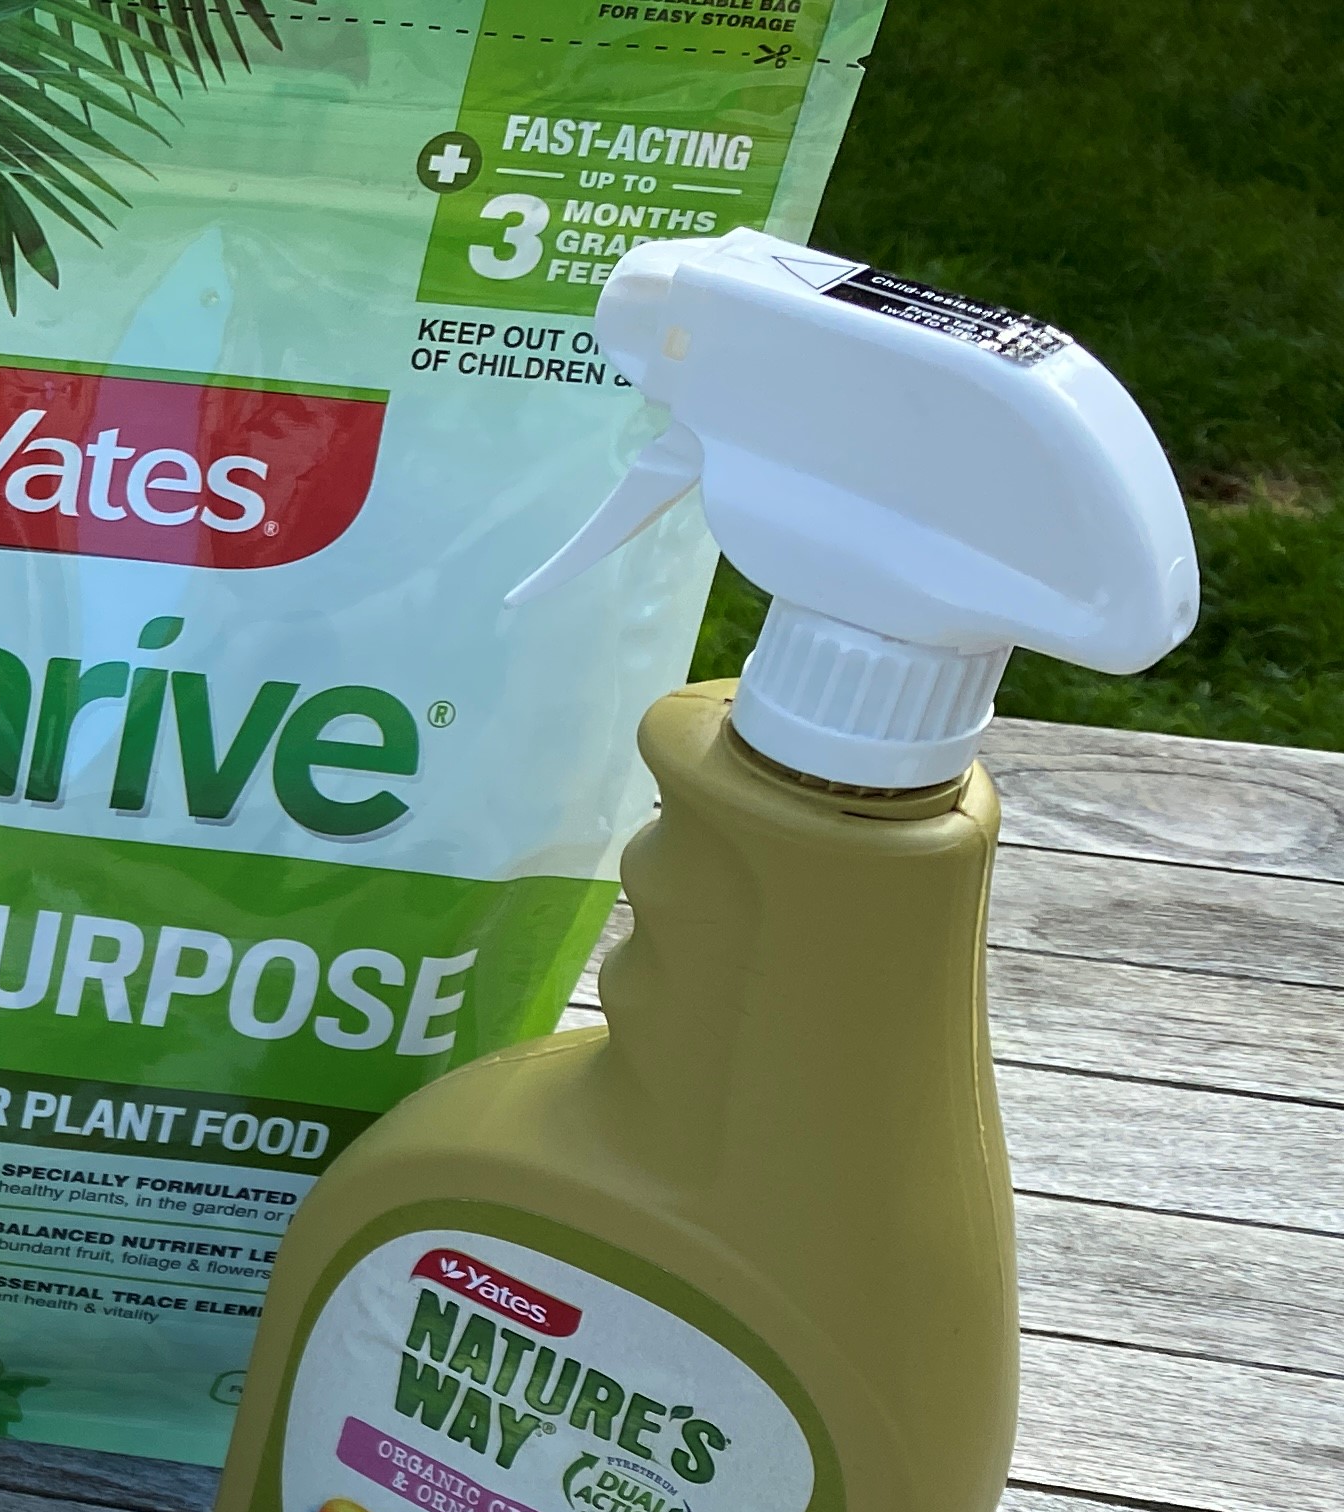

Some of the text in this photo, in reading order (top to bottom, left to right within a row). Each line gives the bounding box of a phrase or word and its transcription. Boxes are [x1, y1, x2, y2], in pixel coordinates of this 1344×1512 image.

[598, 4, 638, 20] FOR
[644, 7, 696, 24] EASY
[701, 12, 796, 32] STORAGE
[503, 114, 754, 172] FAST-ACTING
[579, 169, 657, 193] UP TO
[562, 200, 718, 231] MONTHS
[468, 192, 551, 280] 3
[417, 318, 564, 355] KEEP OUT
[411, 347, 606, 386] OF CHILDREN
[22, 1089, 187, 1147] PLANT
[193, 1107, 330, 1162] FOOD
[1, 1163, 297, 1205] SPECIALLY FORMULATED
[76, 1246, 114, 1264] fruit,
[122, 1251, 181, 1271] foliage
[187, 1259, 200, 1272] &
[207, 1261, 271, 1280] flowers
[122, 1235, 243, 1261] NUTRIENT
[111, 1290, 188, 1311] TRACE
[465, 1267, 547, 1326] Yates
[406, 1289, 729, 1484] NATURE'S
[394, 1350, 542, 1469] WAY
[378, 1440, 481, 1506] ORGANIC
[393, 1471, 408, 1492] &
